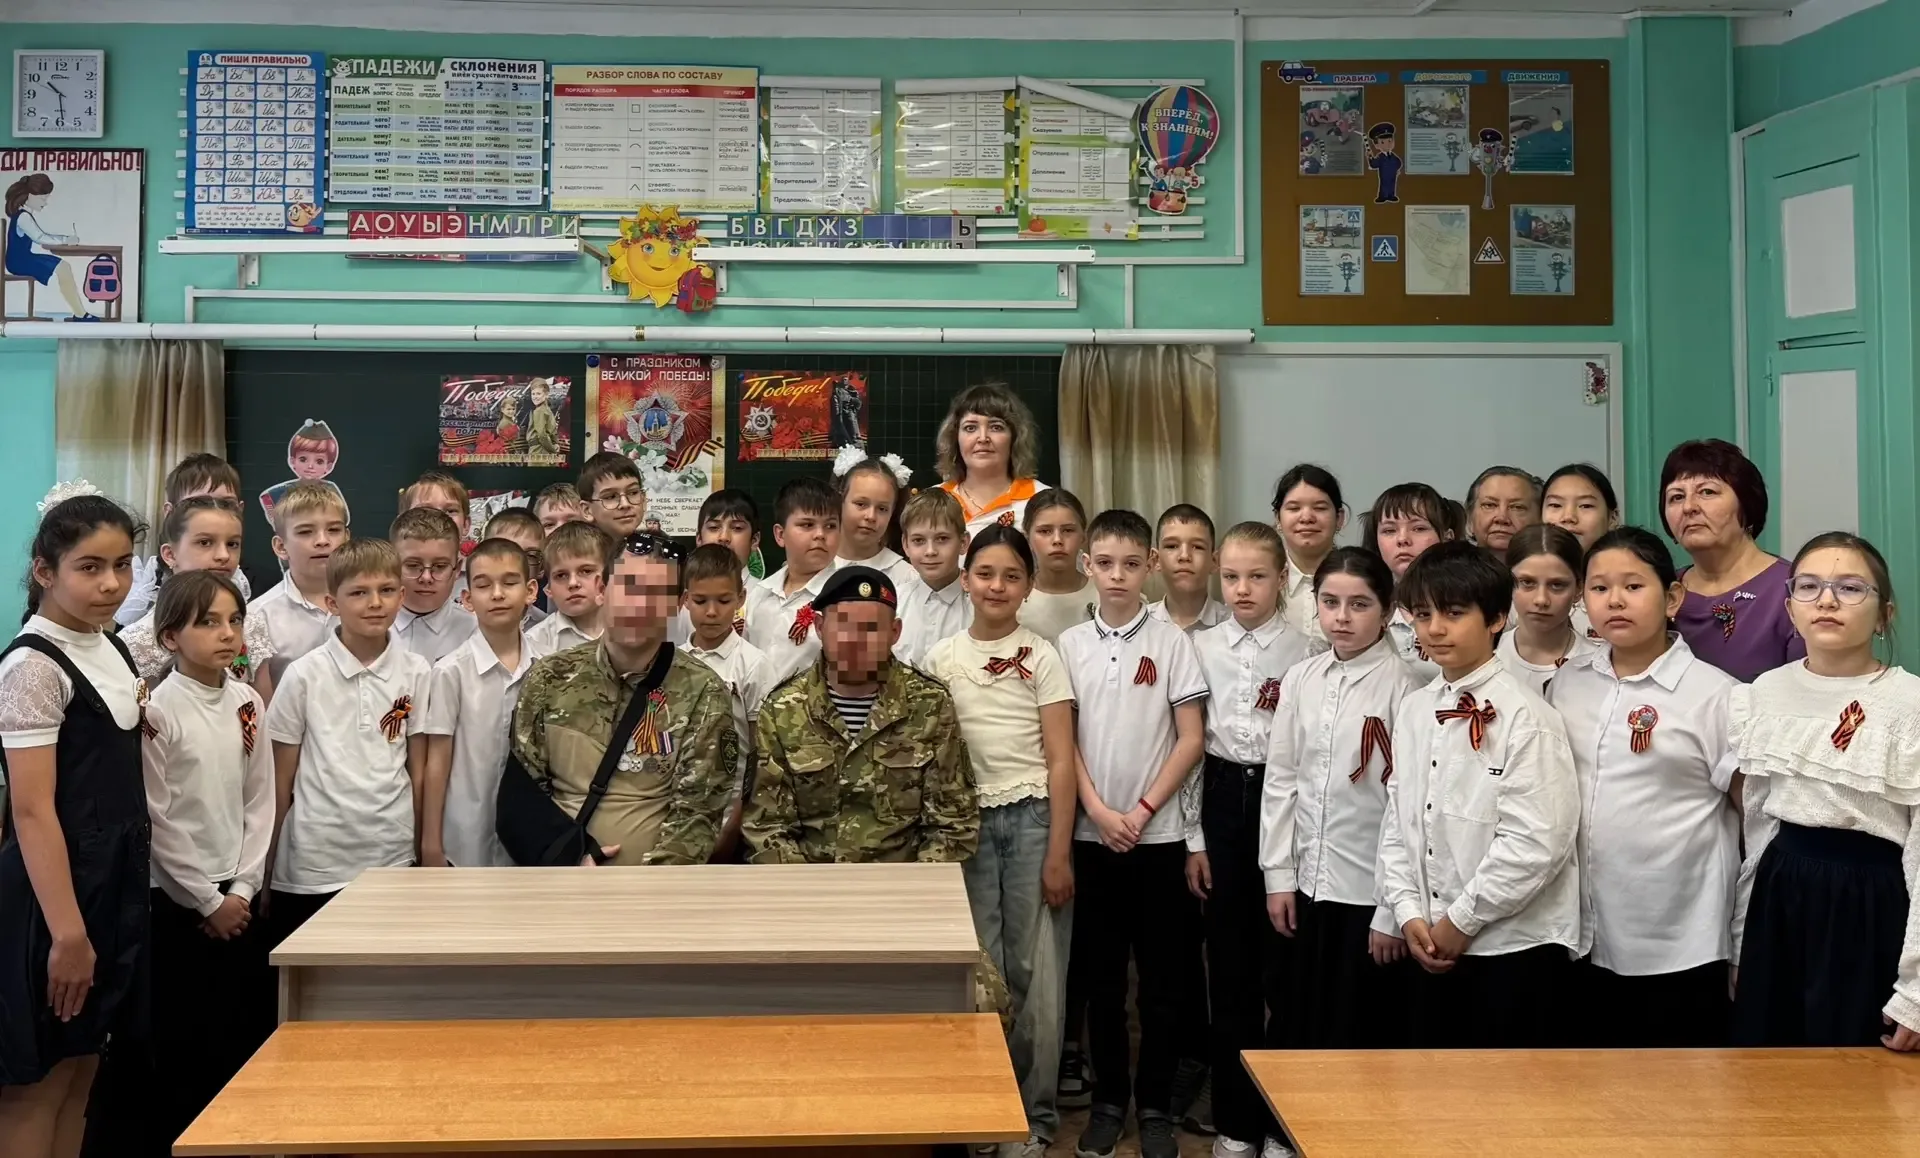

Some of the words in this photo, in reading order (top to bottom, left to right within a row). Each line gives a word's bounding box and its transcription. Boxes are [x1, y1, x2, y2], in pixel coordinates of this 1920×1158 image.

[220, 55, 249, 63] ПИШИ
[251, 55, 308, 64] ПРАВИЛЬНО
[38, 61, 48, 71] 11
[55, 61, 68, 72] 12
[75, 61, 80, 71] 1
[352, 58, 436, 76] ПАДЕЖИ
[28, 73, 41, 83] 10
[85, 71, 94, 81] 2
[200, 69, 216, 80] Аа
[586, 71, 624, 79] РАЗБОР
[626, 71, 660, 79] СЛОВА
[662, 71, 676, 79] ПО
[678, 71, 723, 80] СОСТАВУ
[1333, 75, 1377, 84] ПРАВИЛА
[1414, 72, 1472, 82] ДОРОЖНОГО
[1506, 72, 1561, 82] ДВИЖЕНИЯ
[444, 81, 450, 89] 1
[476, 81, 483, 90] 2
[511, 82, 519, 91] 3
[27, 89, 37, 99] 9
[84, 89, 94, 100] 3
[288, 86, 315, 99] Жж
[334, 85, 370, 97] ПАДЕЖ
[26, 106, 37, 117] 8
[84, 106, 94, 116] 4
[1155, 108, 1203, 123] ВПЕРЁД,
[40, 116, 49, 127] 7
[55, 116, 65, 127] 6
[73, 116, 82, 128] 5
[1140, 123, 1149, 132] К
[1153, 123, 1214, 140] ЗНАНИЯМ!
[33, 151, 141, 171] ПРАВИЛЬНО!
[1191, 176, 1199, 187] 5
[610, 358, 618, 367] С
[626, 357, 701, 368] ПРАЗДНИКОМ
[601, 369, 651, 380] ВЕЛИКОЙ
[659, 370, 711, 381] ПОБЕДЫ!
[442, 379, 532, 411] Победа!
[743, 375, 831, 407] Победа!
